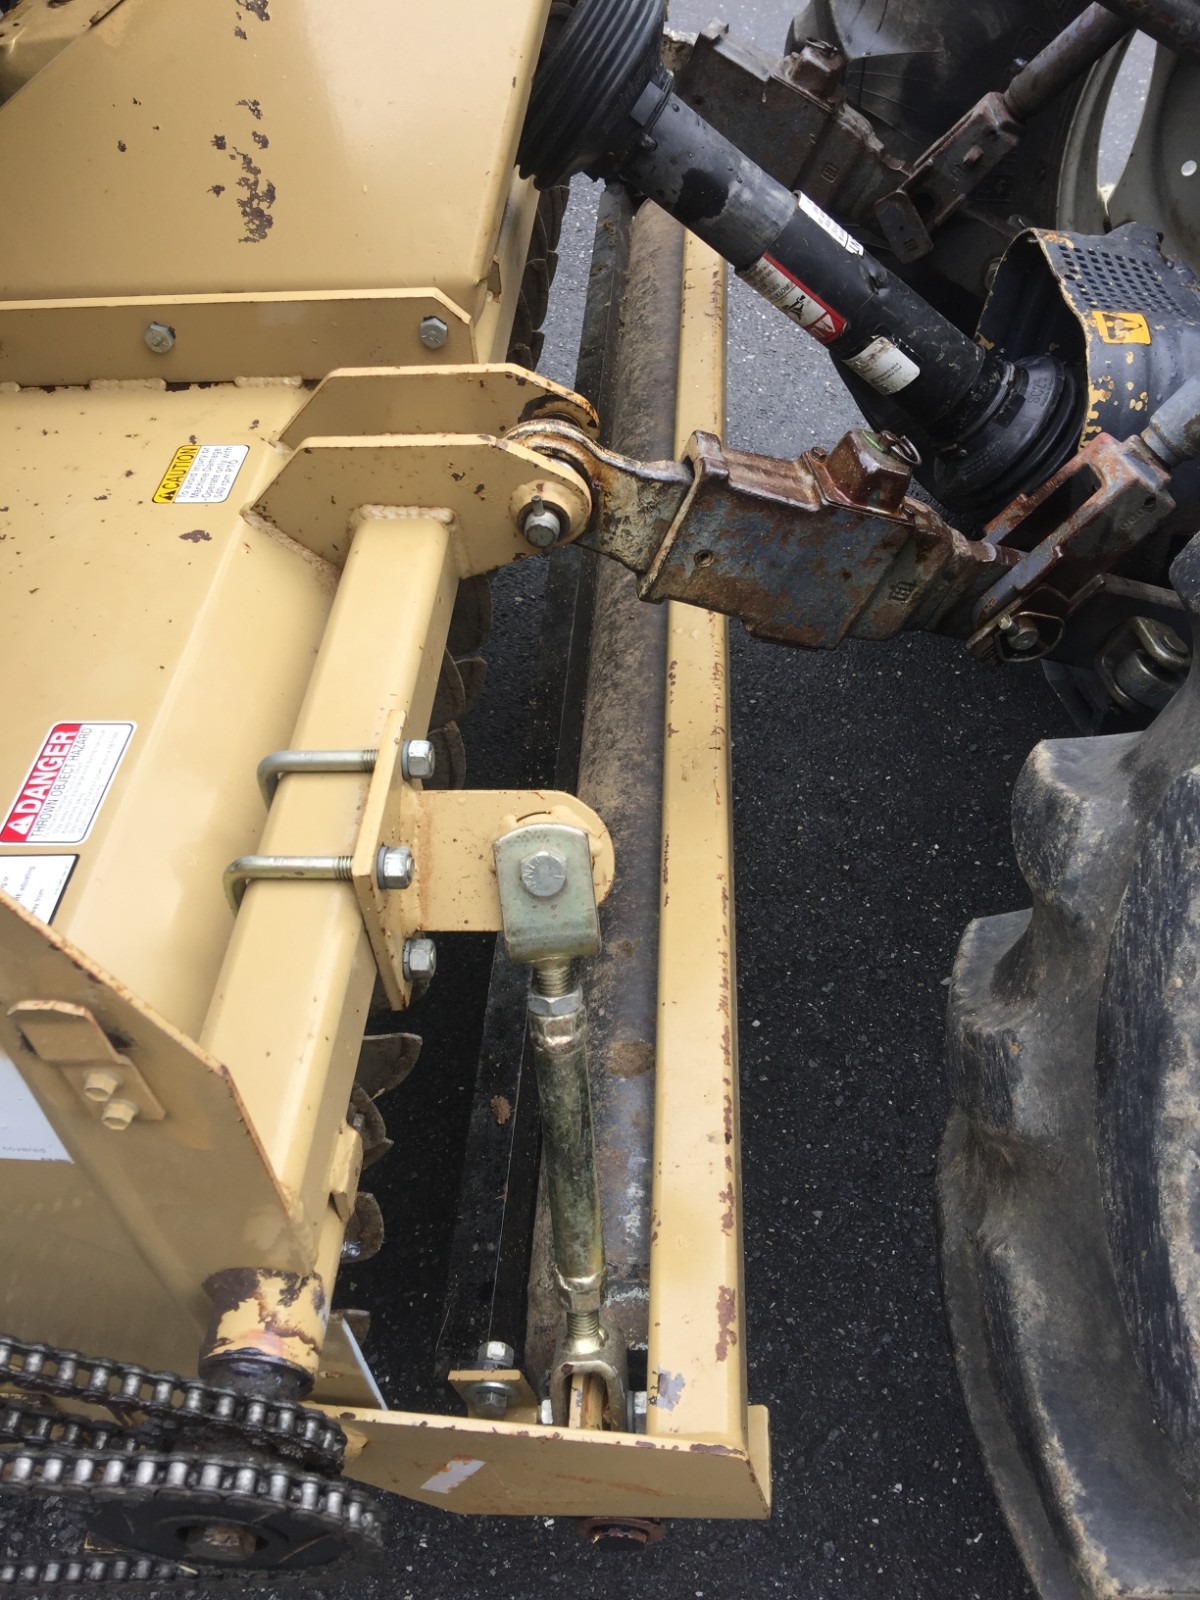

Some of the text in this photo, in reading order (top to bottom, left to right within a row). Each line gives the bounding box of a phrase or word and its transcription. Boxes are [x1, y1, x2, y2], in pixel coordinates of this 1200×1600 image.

[162, 448, 198, 489] CAUTION
[184, 473, 198, 489] avoid
[189, 447, 222, 498] Machine Damage
[215, 460, 228, 473] only
[222, 446, 233, 458] with
[15, 731, 78, 813] DANGER
[30, 800, 59, 837] THROWN
[51, 764, 75, 796] OBJECT
[70, 727, 92, 762] HAZARD
